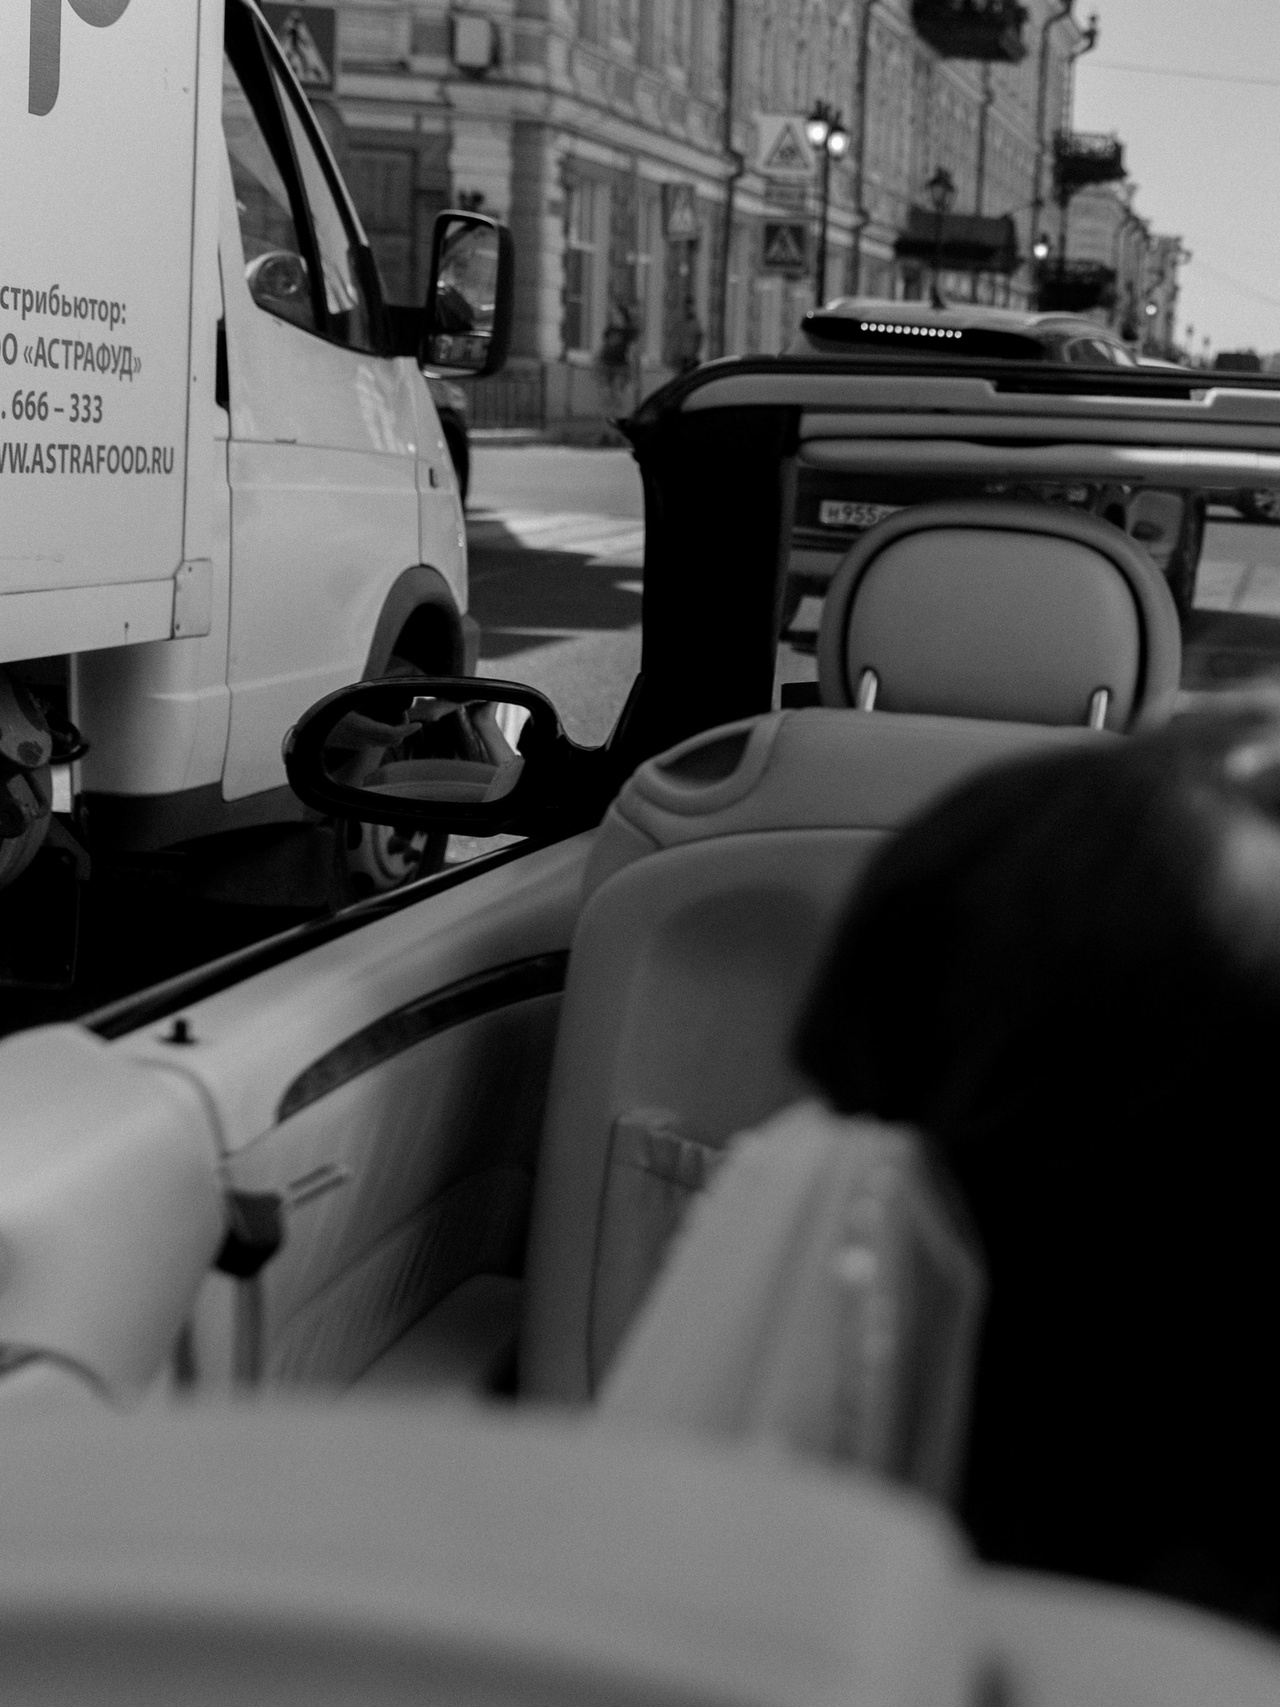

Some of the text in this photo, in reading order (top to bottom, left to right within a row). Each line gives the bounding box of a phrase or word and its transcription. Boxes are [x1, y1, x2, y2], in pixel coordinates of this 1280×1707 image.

[0, 284, 126, 331] стрибьютор:
[0, 333, 142, 382] О «АСТРАФУД»
[12, 389, 49, 421] 666
[69, 393, 103, 423] 333
[0, 442, 174, 475] W.ASTRAFOOD.RU
